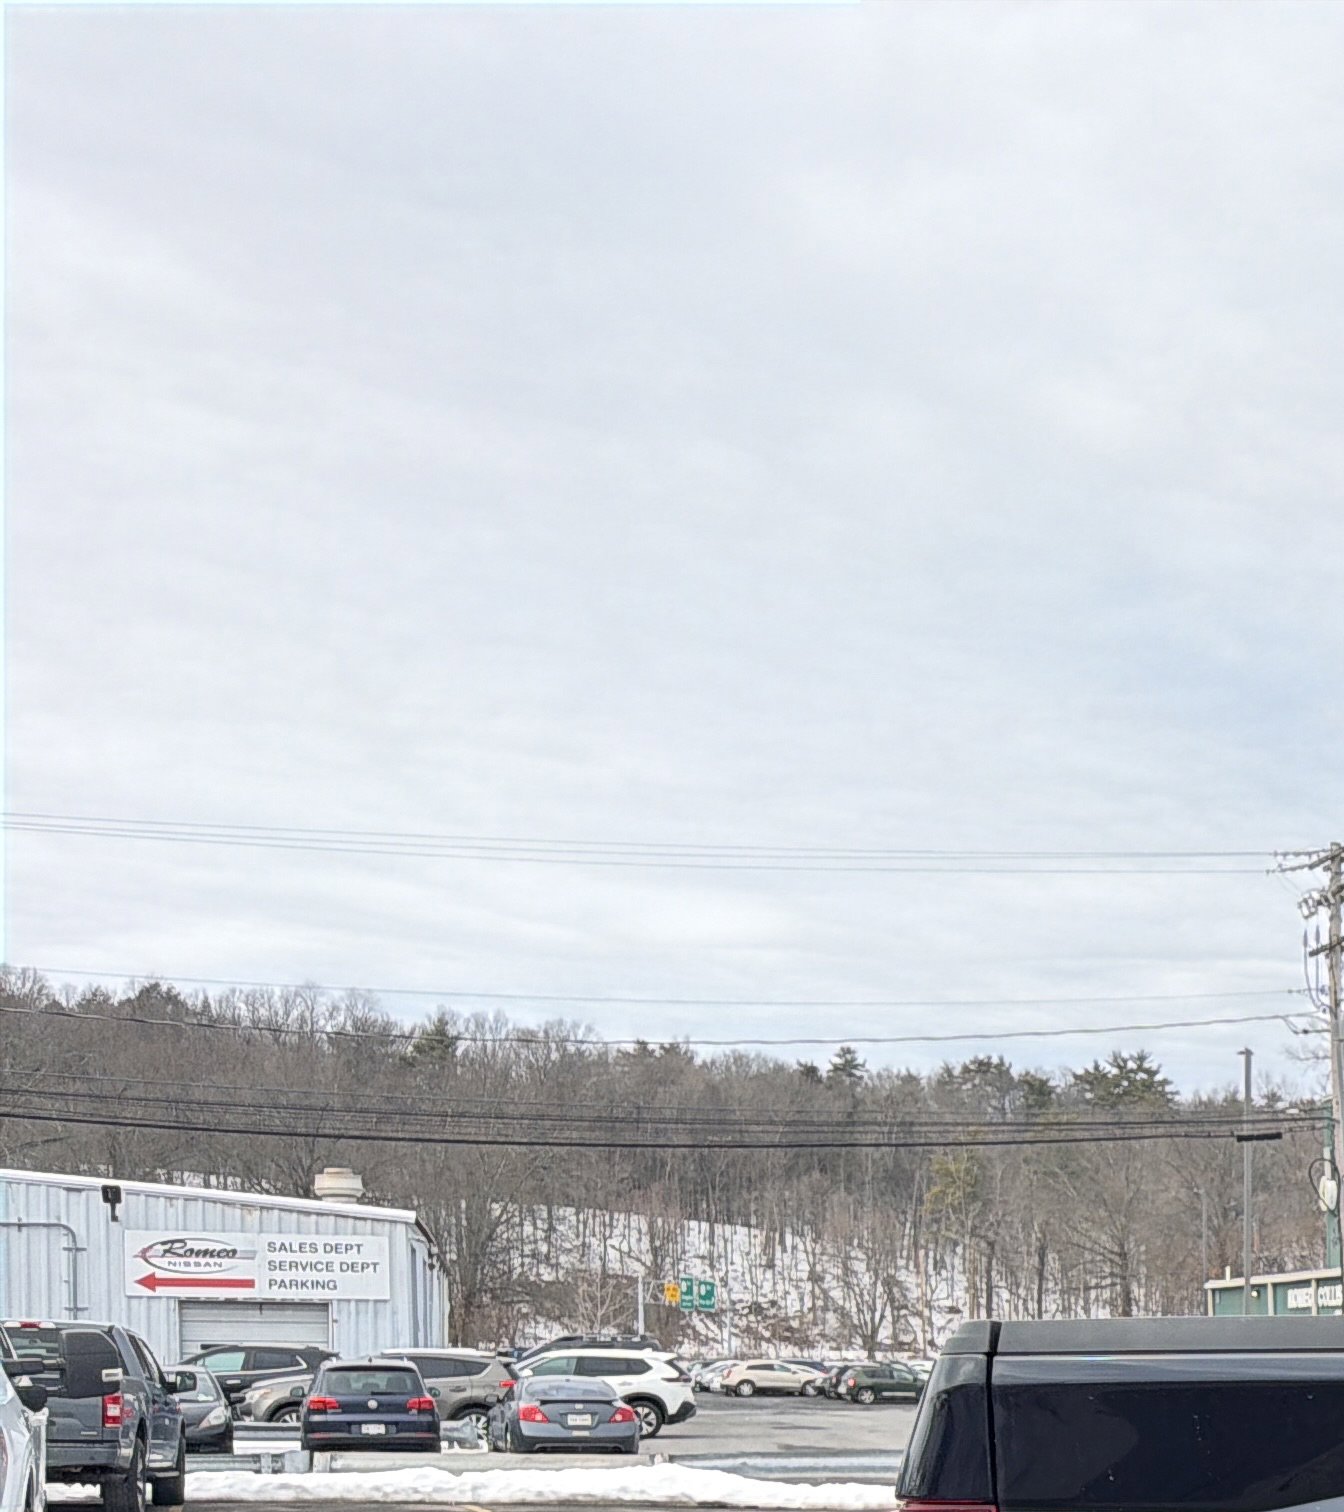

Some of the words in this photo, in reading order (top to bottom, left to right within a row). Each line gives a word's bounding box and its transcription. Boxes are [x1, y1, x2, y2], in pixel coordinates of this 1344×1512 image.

[160, 1238, 238, 1259] Romeo
[267, 1241, 319, 1254] SALES
[323, 1243, 364, 1255] DEPT
[267, 1261, 335, 1273] SERVICE
[339, 1262, 380, 1273] DEPT
[268, 1279, 338, 1291] PARKING
